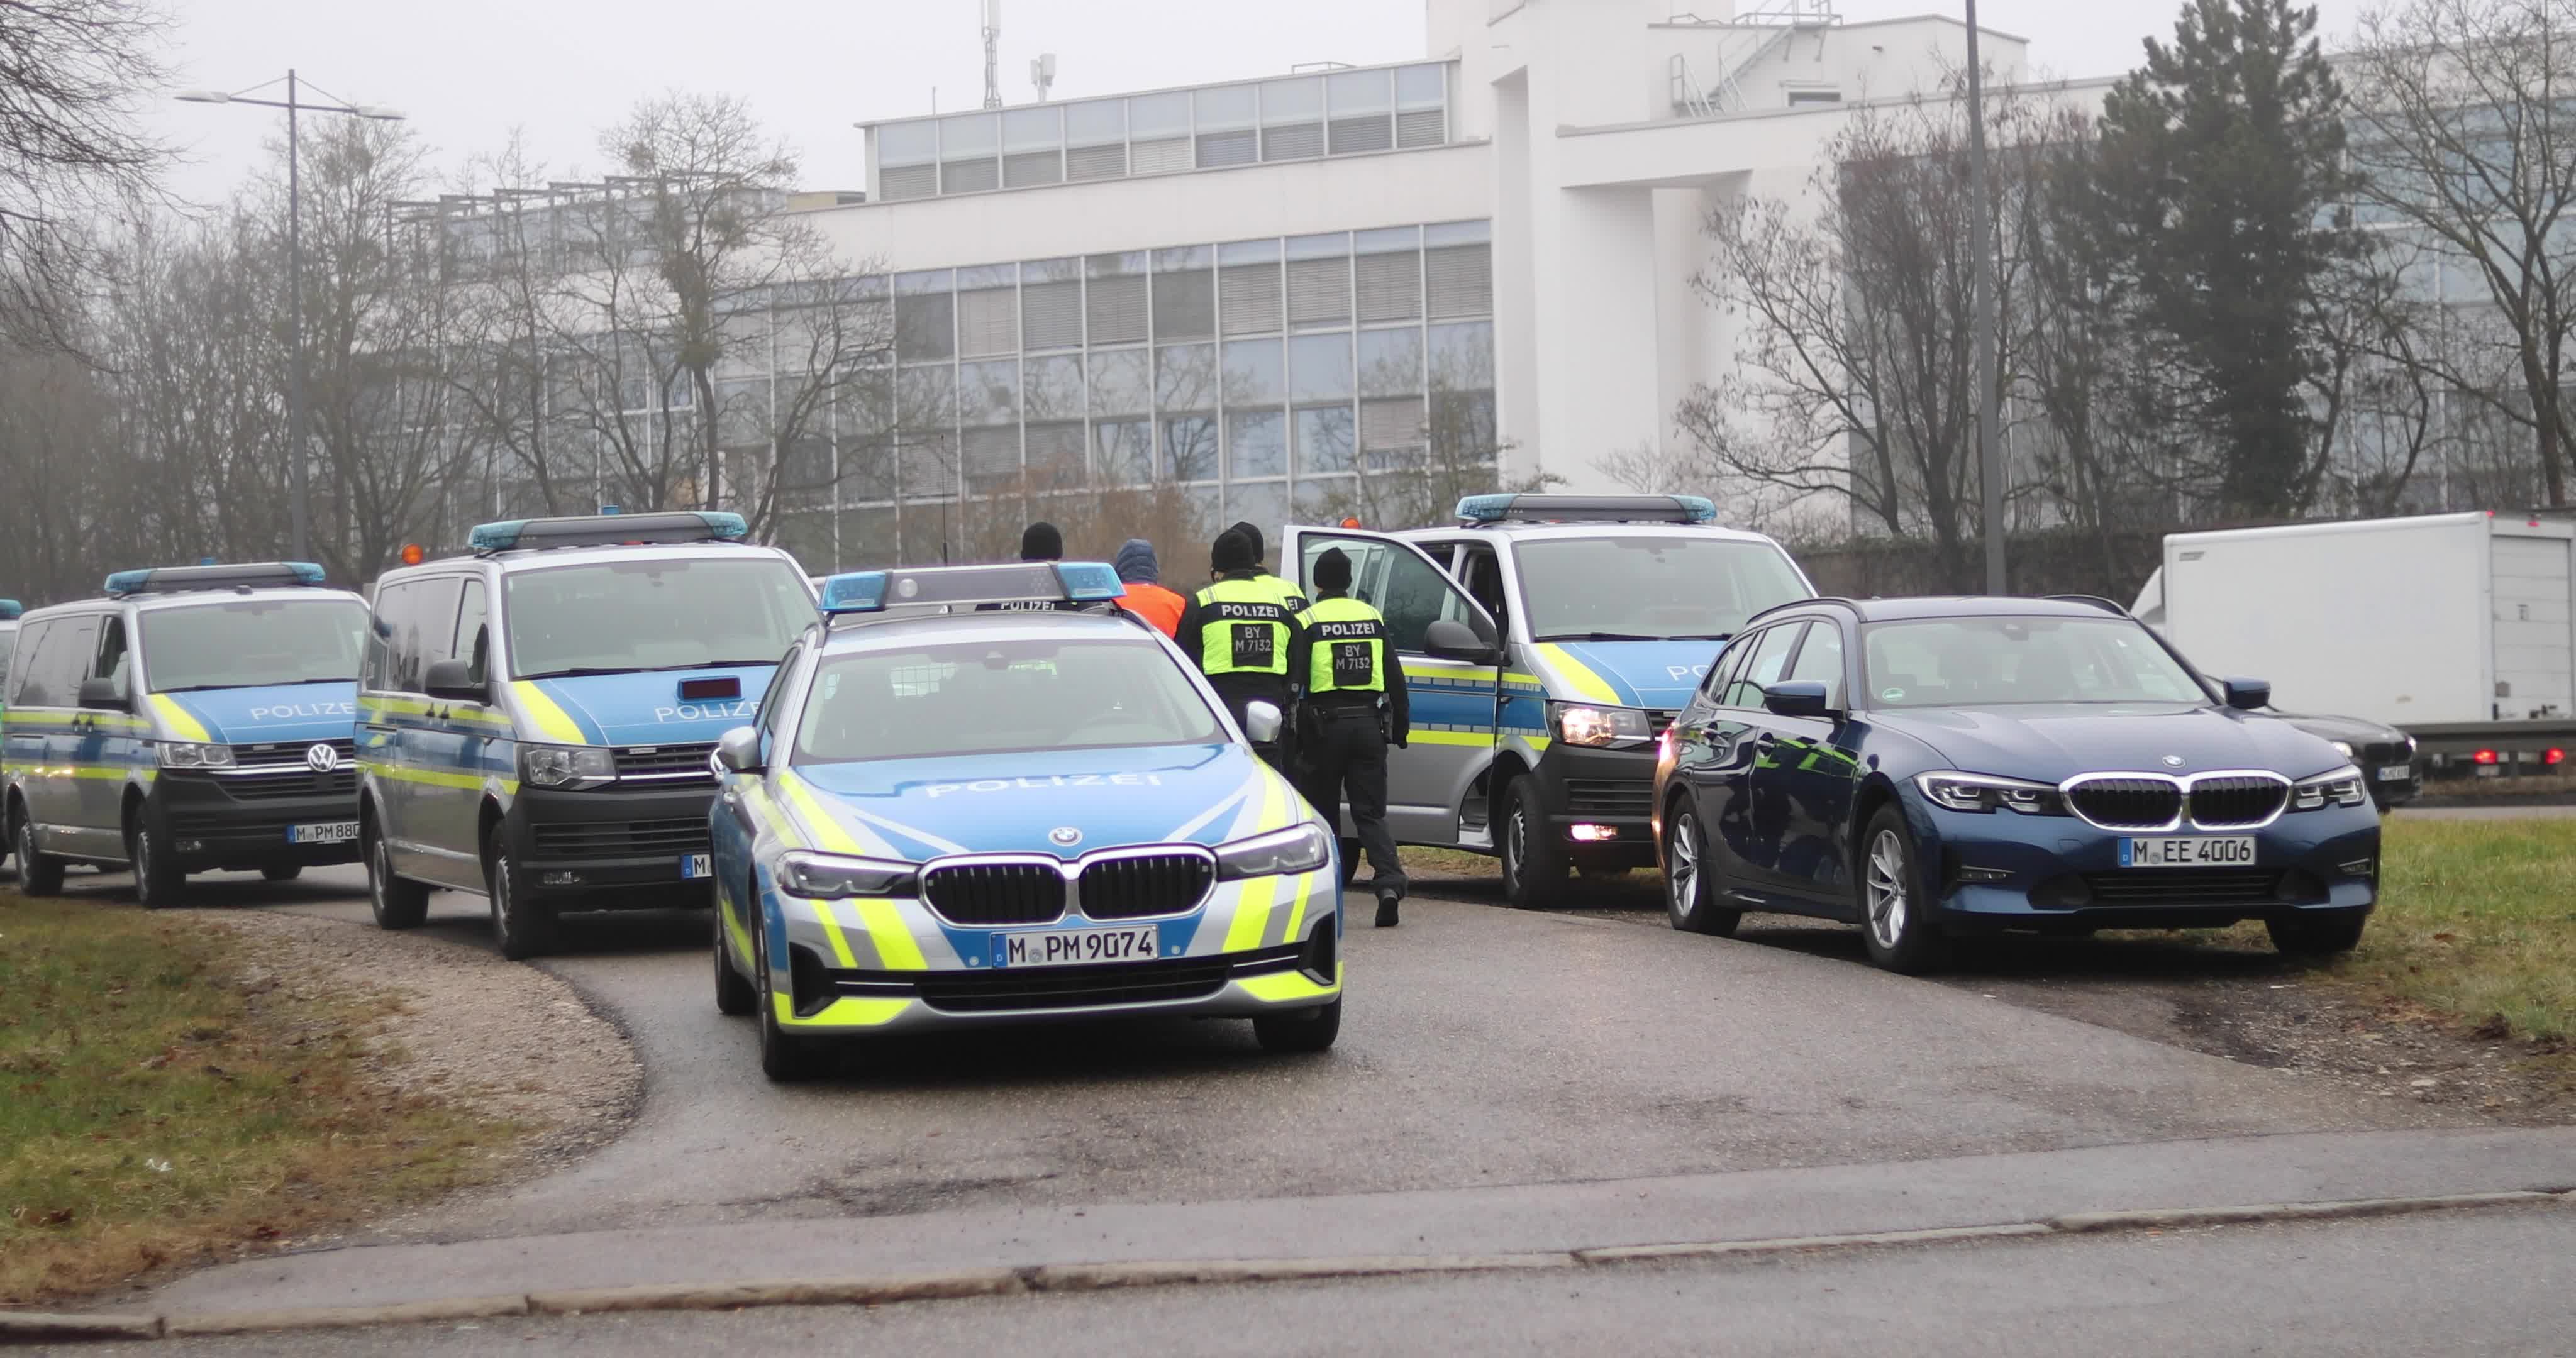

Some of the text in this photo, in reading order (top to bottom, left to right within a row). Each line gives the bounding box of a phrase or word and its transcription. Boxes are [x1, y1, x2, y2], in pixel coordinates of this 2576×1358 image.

[1001, 601, 1055, 611] POLIZEI
[1221, 605, 1279, 618] POLIZEI
[1245, 627, 1261, 639] BY
[1321, 622, 1375, 636] POLIZEI
[1235, 639, 1272, 652] M 7132
[1345, 644, 1360, 657] BY
[1336, 657, 1370, 670] M 7132
[250, 702, 356, 720] POLIZE
[308, 744, 338, 773] VW
[926, 774, 1162, 798] POLIZEI
[296, 827, 306, 841] M
[315, 825, 333, 839] PM
[2133, 841, 2148, 863] M
[2163, 840, 2192, 863] EE
[2197, 840, 2251, 862] 4006
[694, 857, 706, 875] M
[996, 930, 1153, 963] D M PM 9074
